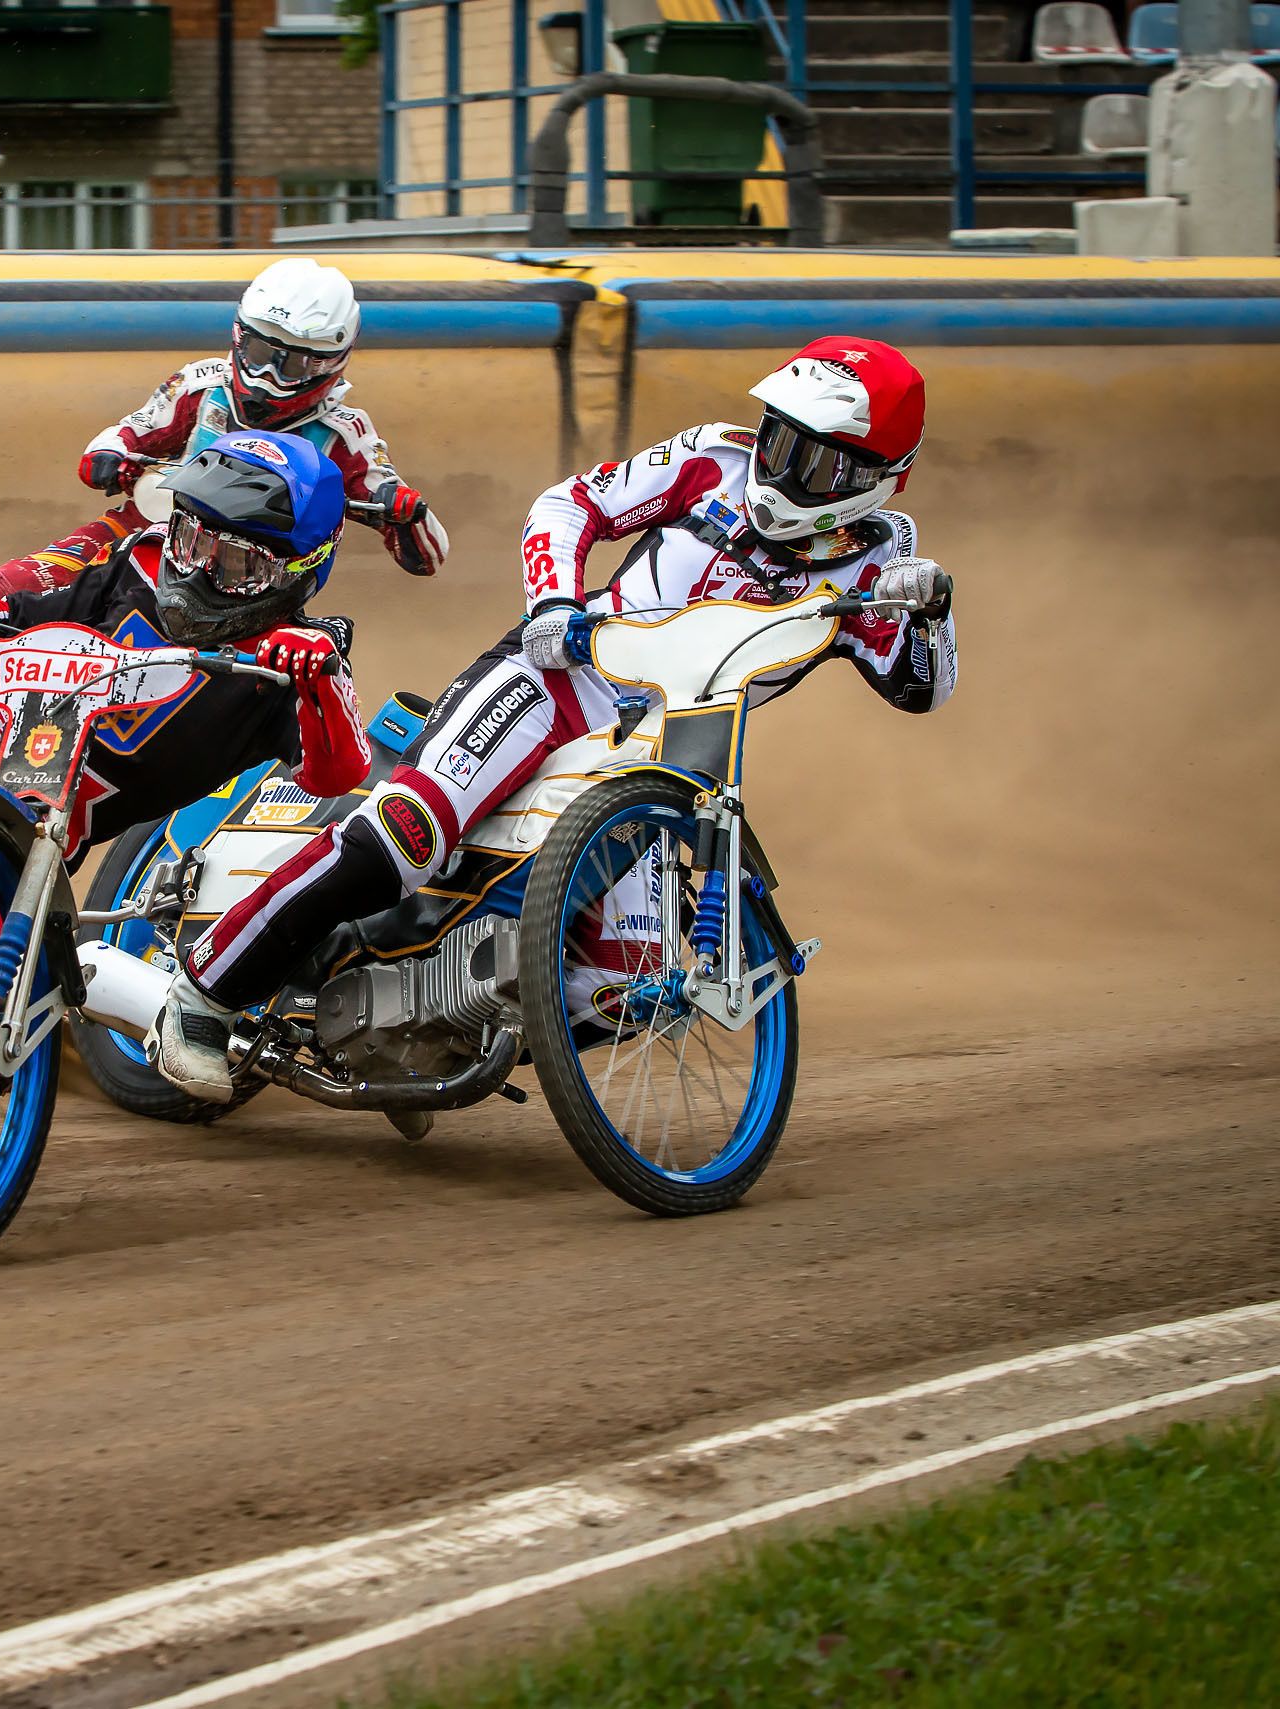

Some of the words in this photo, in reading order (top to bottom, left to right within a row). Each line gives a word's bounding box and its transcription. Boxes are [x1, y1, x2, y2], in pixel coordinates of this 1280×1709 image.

[614, 497, 663, 527] BRODDSON
[466, 681, 535, 753] Silkolene
[450, 752, 470, 777] FUCHS
[390, 798, 430, 860] HEJLA
